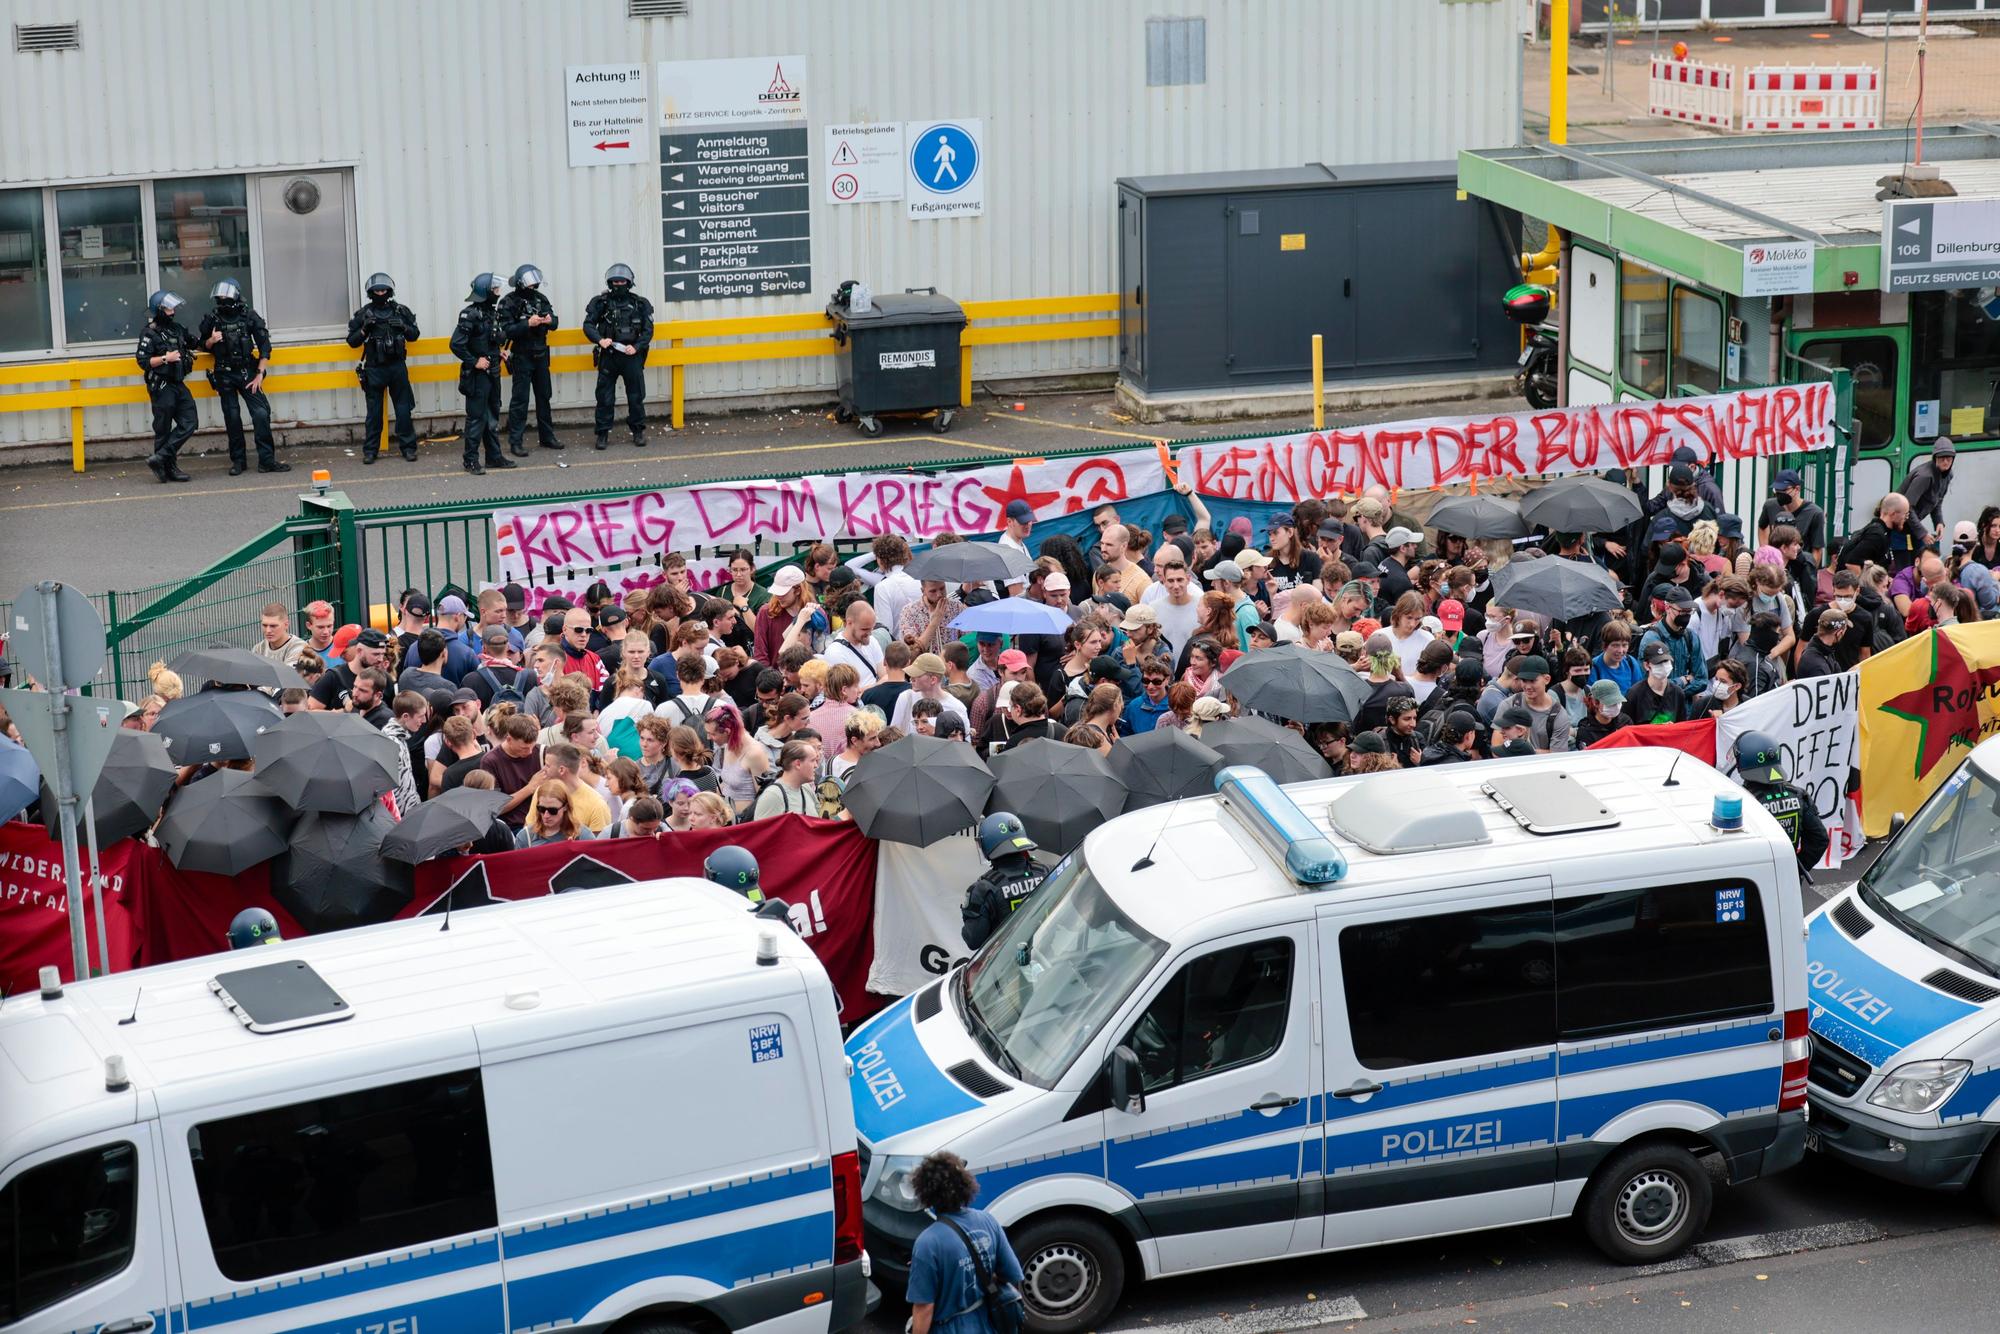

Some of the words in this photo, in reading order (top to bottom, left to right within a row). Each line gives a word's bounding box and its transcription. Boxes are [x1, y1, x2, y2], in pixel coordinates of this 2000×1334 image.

[575, 72, 626, 83] Achtung
[629, 69, 641, 80] !!!
[592, 98, 618, 106] stehen
[619, 96, 647, 105] bleiben
[758, 92, 801, 101] DEUTZ
[664, 112, 693, 120] DEUTZ
[694, 110, 730, 119] SERVICE
[731, 108, 763, 117] Logistik
[767, 107, 802, 115] Zentrum
[572, 119, 587, 127] Bis
[588, 119, 601, 127] zur
[604, 117, 644, 126] Haltelinie
[589, 127, 630, 137] vorfahren
[696, 136, 768, 148] Anmeldung
[697, 146, 770, 160] registration
[697, 162, 790, 176] Wareneingang
[698, 175, 744, 185] receiving
[746, 171, 805, 183] department
[836, 180, 854, 193] 30
[699, 191, 760, 203] Besucher
[699, 203, 745, 213] visitors
[699, 217, 751, 229] Versand
[699, 228, 758, 241] shipment
[700, 244, 759, 257] Parkplatz
[1766, 248, 1808, 261] MoVeKo
[1897, 244, 1921, 256] 106
[700, 256, 747, 269] parking
[698, 270, 789, 283] Komponenten-
[1893, 274, 1930, 285] DEUTZ
[1932, 271, 1979, 283] SERVICE
[698, 283, 754, 295] fertigung
[760, 280, 806, 291] Service
[881, 351, 931, 364] REMONDIS
[1194, 442, 1301, 502] KEIN
[1307, 429, 1424, 499] CENT
[1426, 416, 1528, 483] DER
[1530, 384, 1831, 474] BUNDESWEHR!!
[512, 491, 676, 573] KRIEG
[689, 479, 825, 539] DEM
[838, 476, 993, 537] KRIEG
[1719, 889, 1741, 900] NRW
[1716, 902, 1723, 911] 3
[1722, 901, 1734, 910] BF
[1734, 899, 1745, 908] 13
[1807, 960, 1894, 1026] POLIZEI
[750, 1025, 779, 1040] NRW
[752, 1039, 759, 1051] 3
[760, 1038, 774, 1050] BF
[775, 1036, 781, 1047] 1
[756, 1048, 780, 1063] BeSi
[852, 1040, 907, 1112] POLIZEI
[1381, 1118, 1502, 1158] POLIZEI
